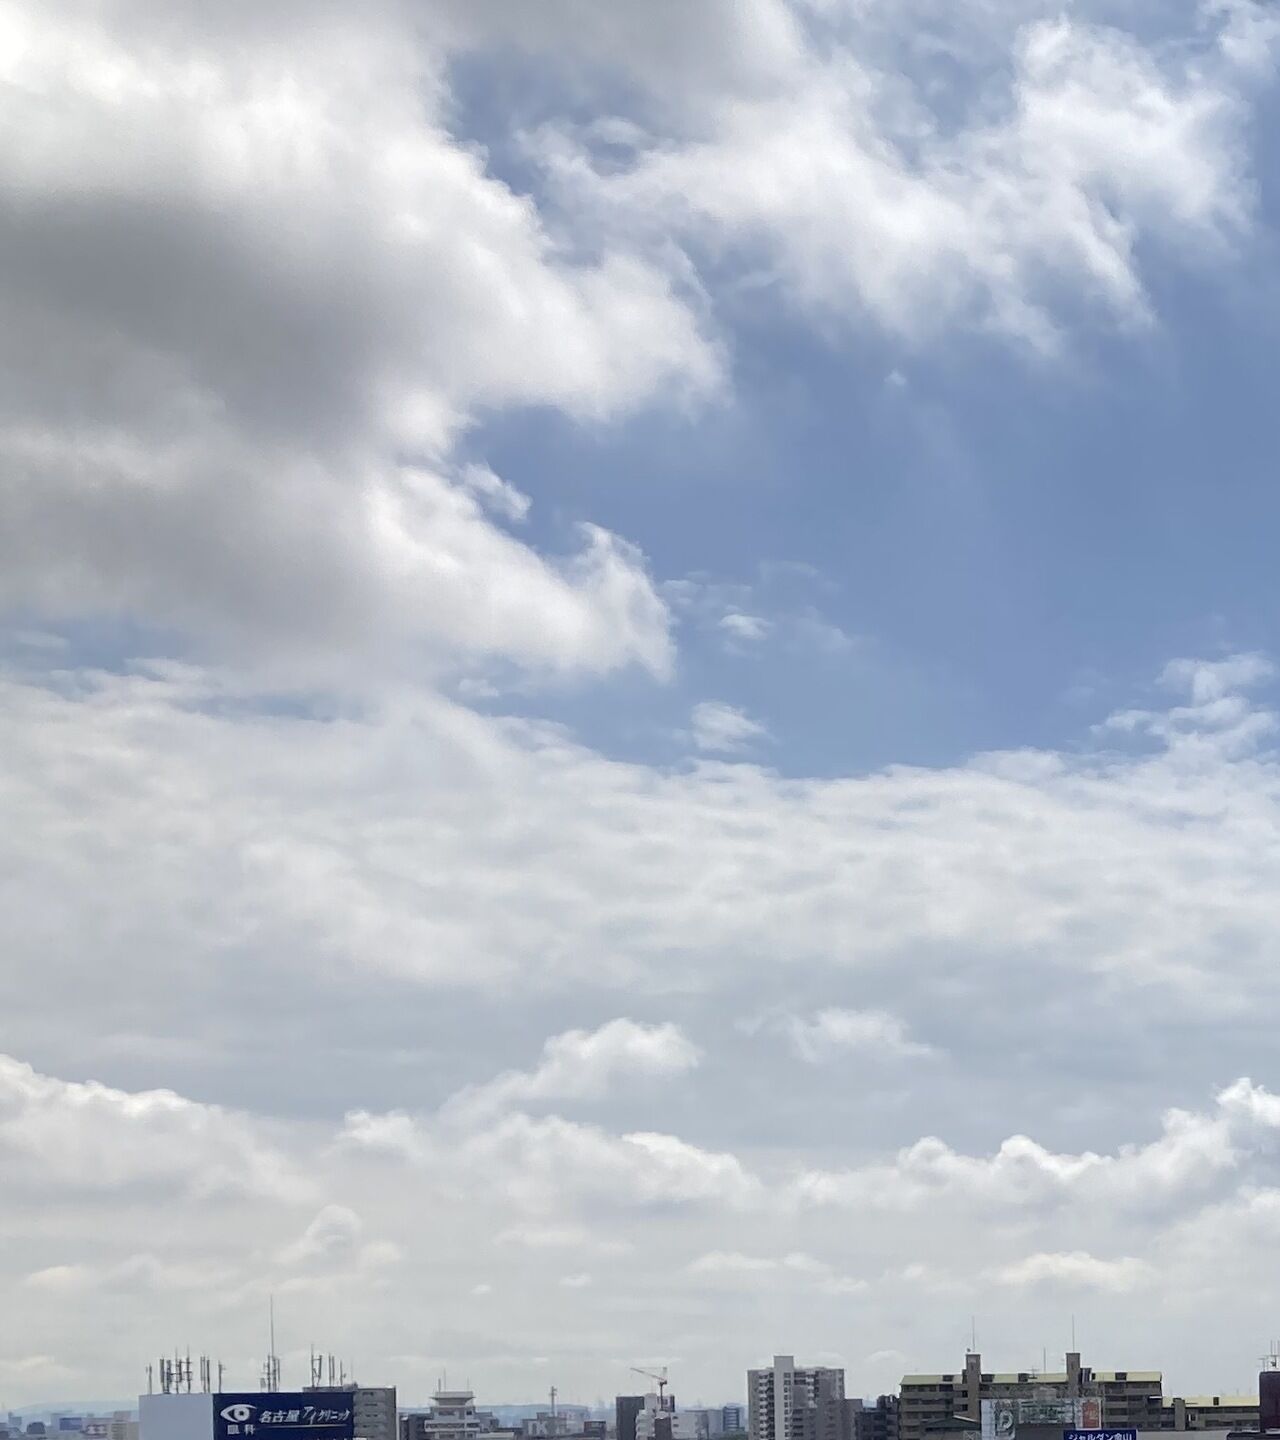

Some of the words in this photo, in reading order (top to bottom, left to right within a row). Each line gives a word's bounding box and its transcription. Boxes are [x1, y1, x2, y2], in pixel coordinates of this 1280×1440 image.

[259, 1405, 351, 1425] 名古屋アイクリニック
